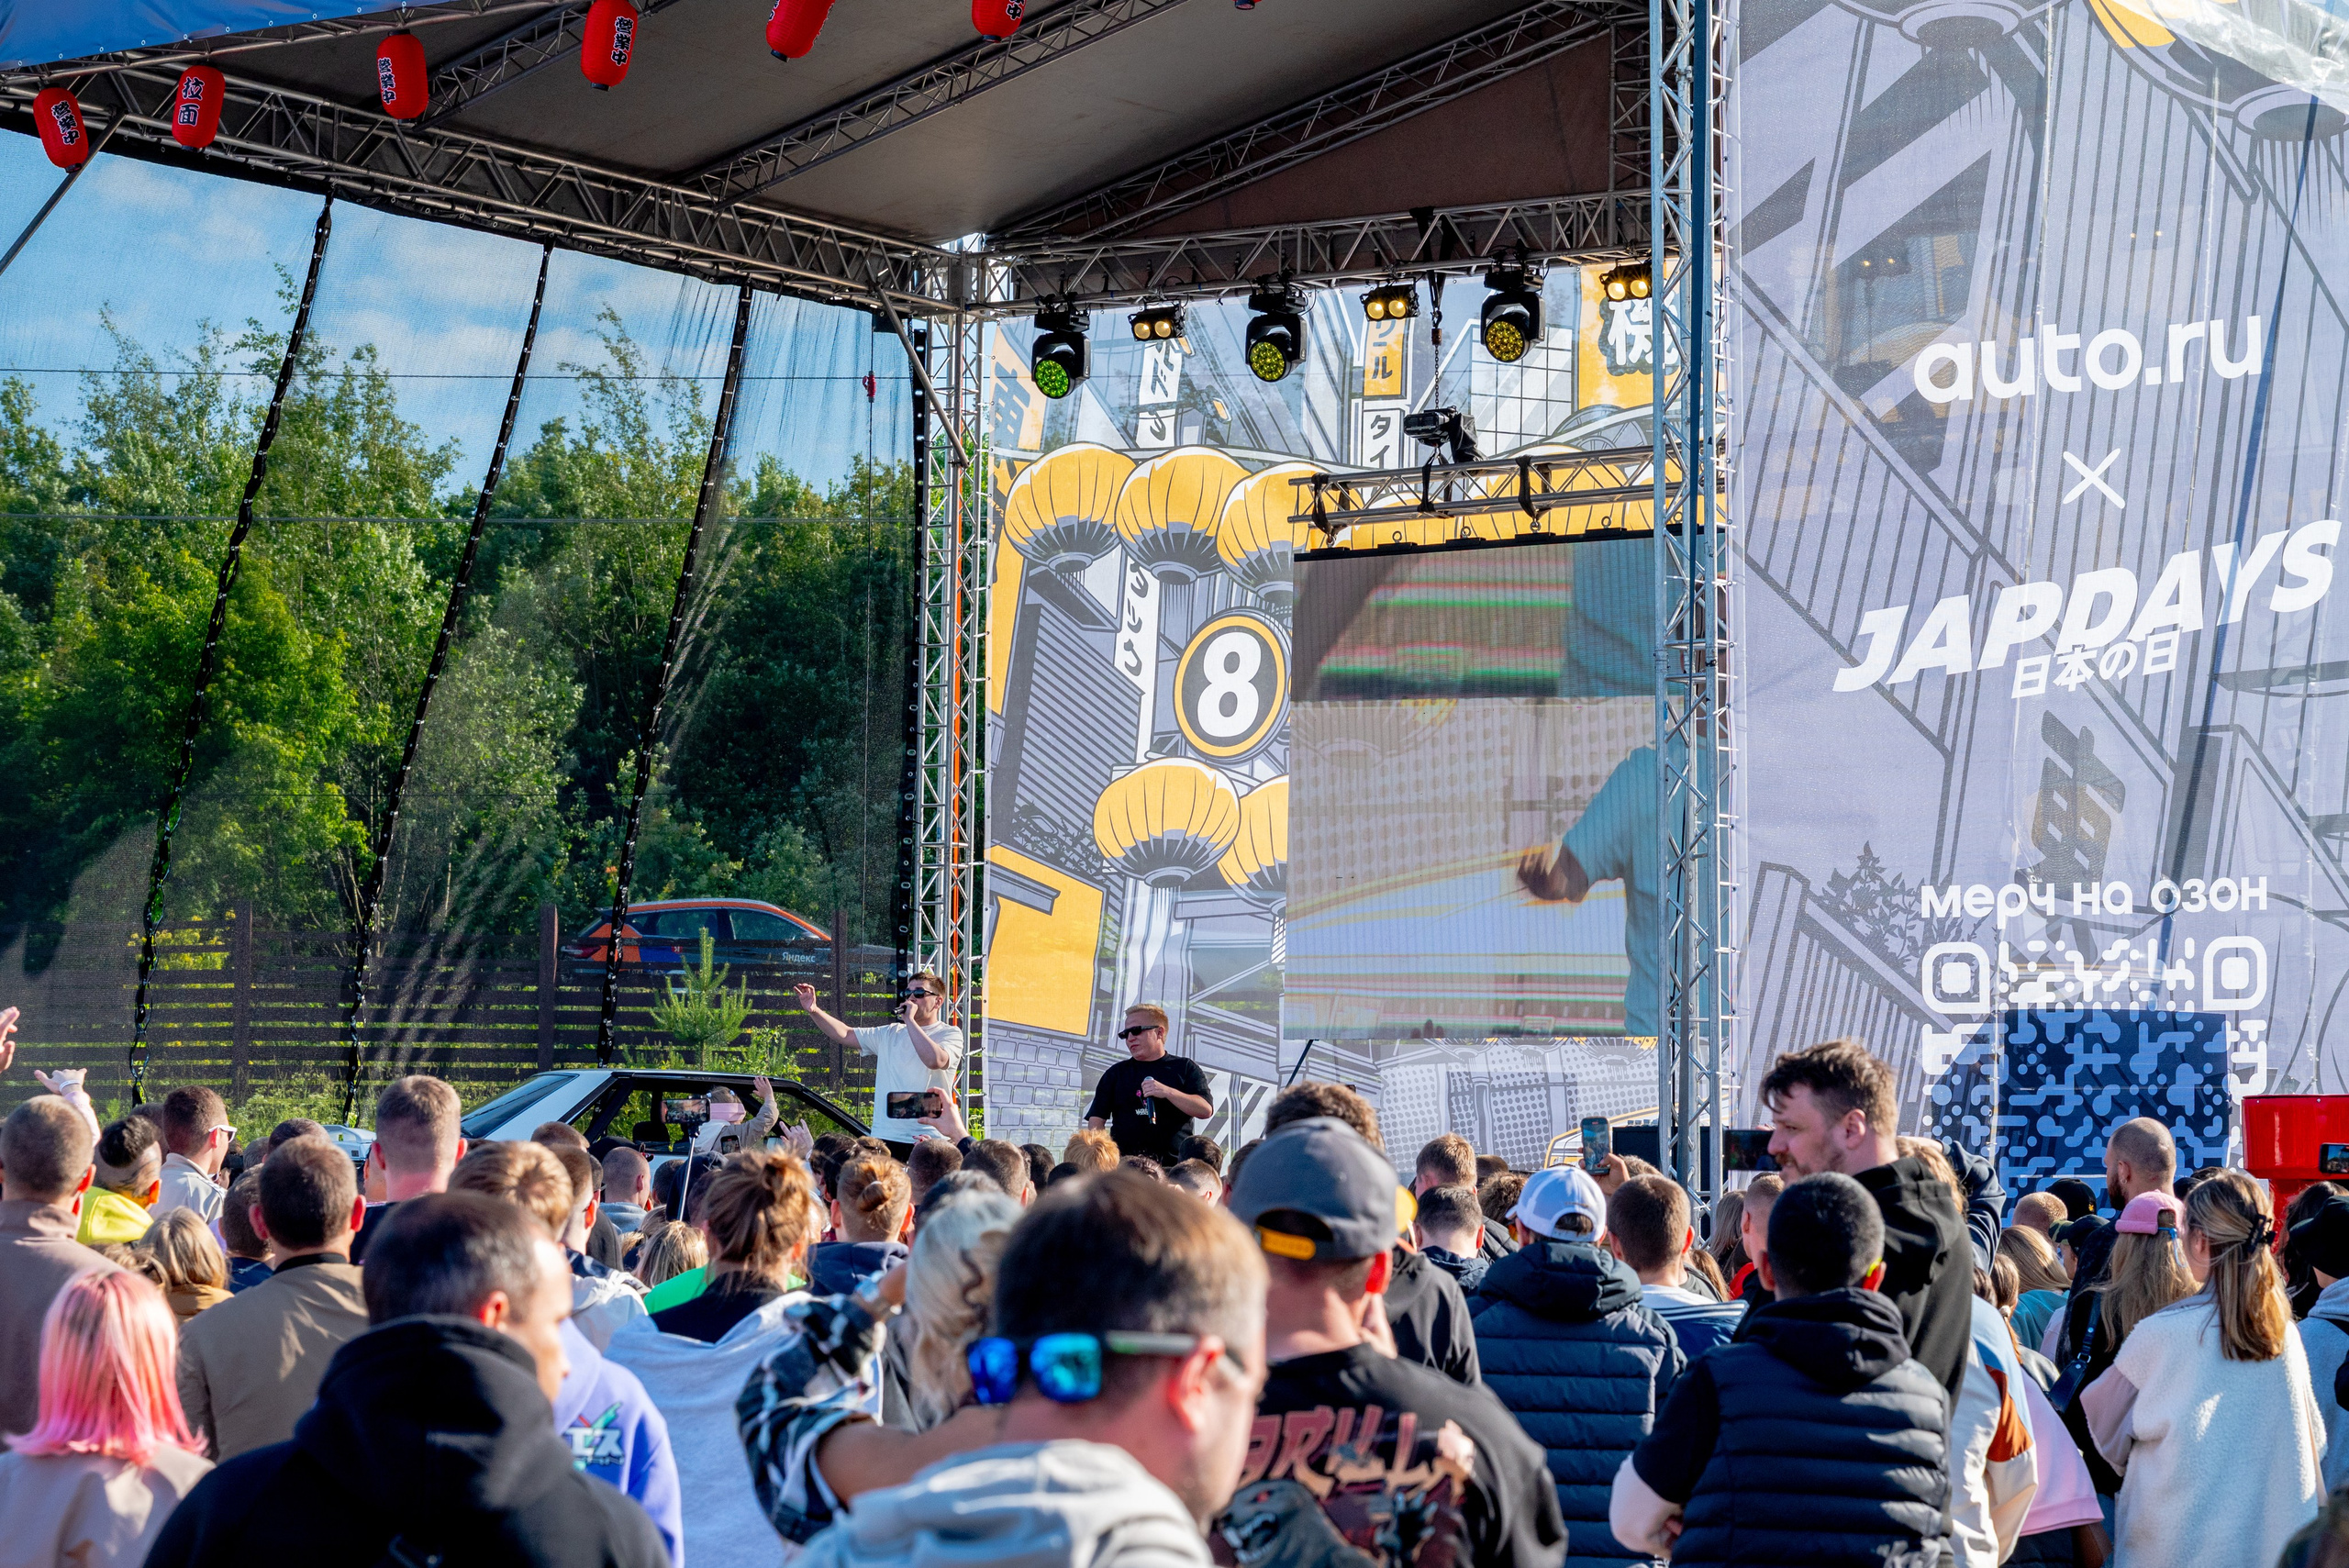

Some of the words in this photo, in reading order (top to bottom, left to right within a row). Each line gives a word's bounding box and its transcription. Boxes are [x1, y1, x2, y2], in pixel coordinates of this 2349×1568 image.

[178, 76, 205, 127] 拉面
[1914, 315, 2262, 403] auto.ru
[1832, 520, 2342, 693] JAPDAYS
[1197, 631, 1262, 738] 8
[2011, 630, 2180, 700] 日本の日
[1921, 883, 2055, 929] мерч
[2073, 881, 2133, 916] на
[2151, 876, 2267, 914] озон
[782, 951, 816, 962] Яндекс
